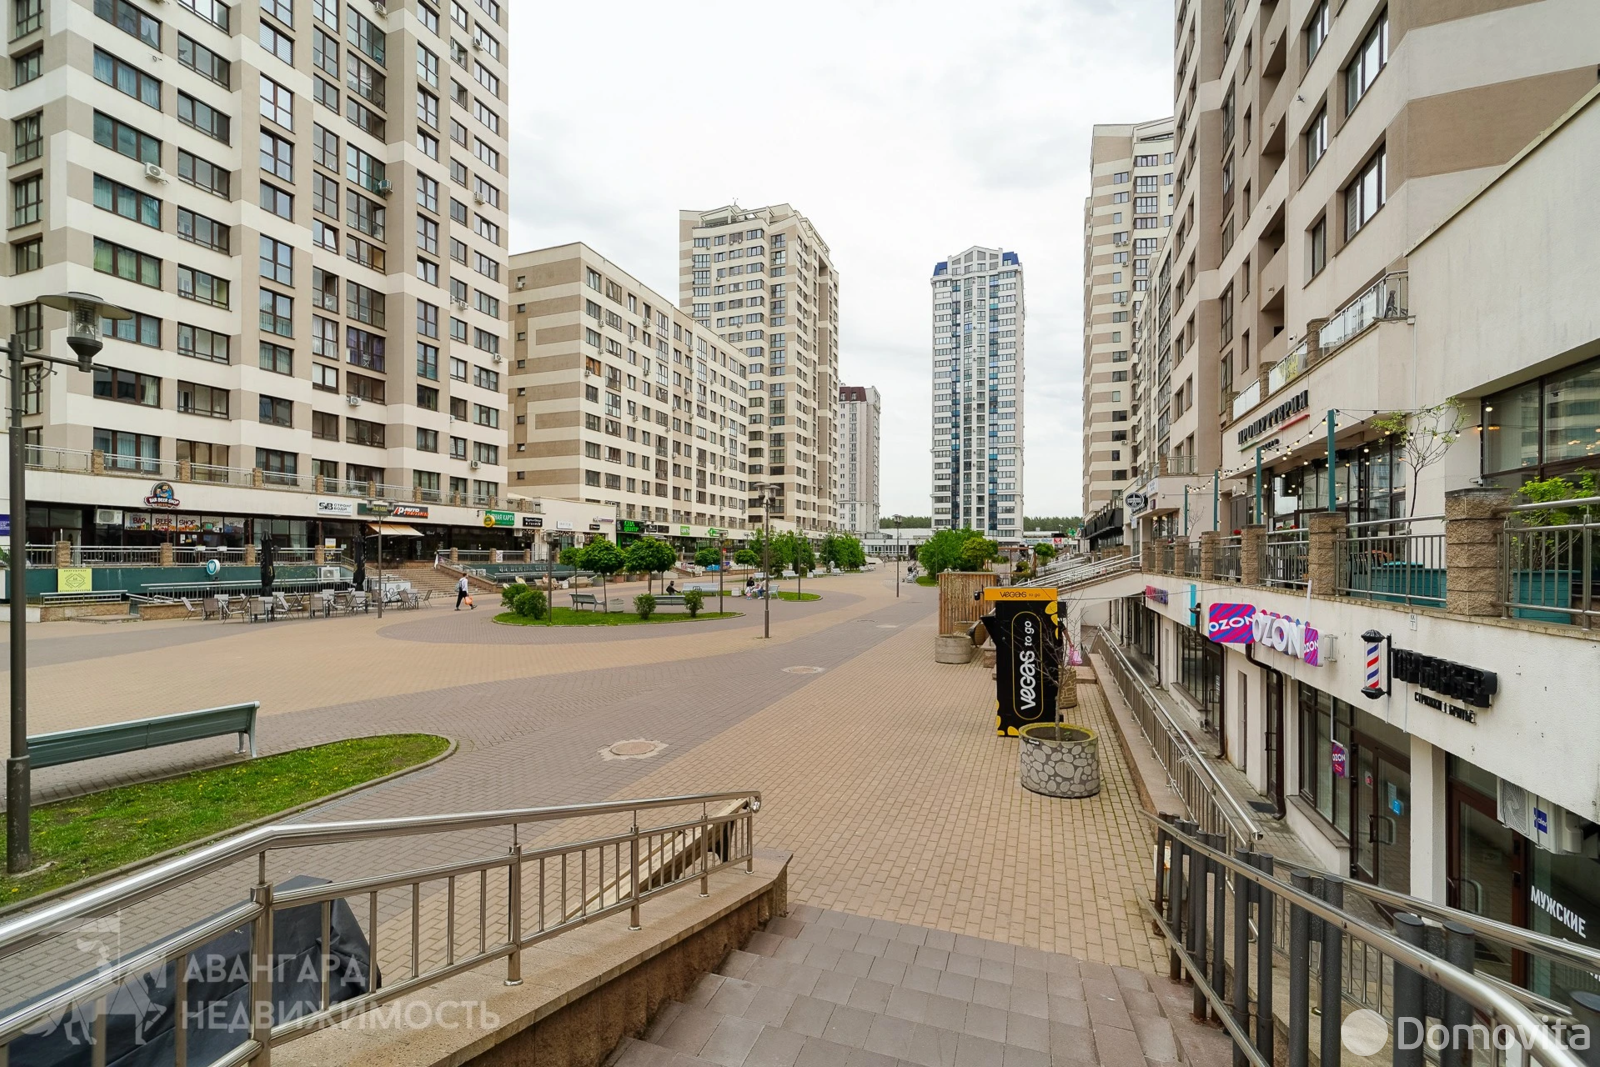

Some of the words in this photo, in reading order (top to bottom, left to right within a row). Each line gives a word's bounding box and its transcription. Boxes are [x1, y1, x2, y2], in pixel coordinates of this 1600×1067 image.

[1024, 620, 1035, 635] go
[1208, 615, 1254, 632] OZON
[1024, 636, 1033, 646] to
[1252, 612, 1306, 659] OZON
[1332, 753, 1346, 762] OZON
[1531, 885, 1587, 939] МУЖСКИЕ
